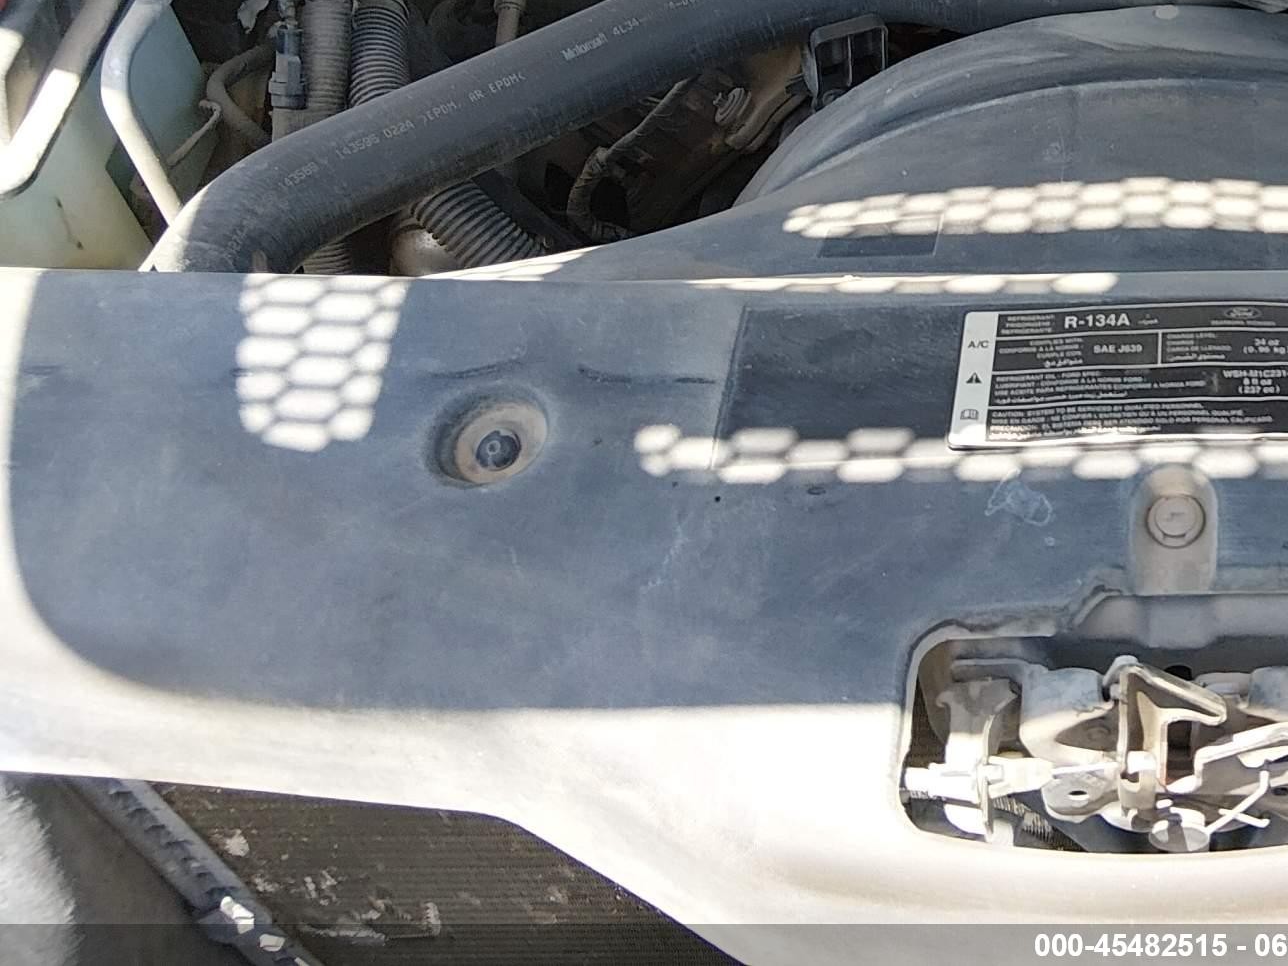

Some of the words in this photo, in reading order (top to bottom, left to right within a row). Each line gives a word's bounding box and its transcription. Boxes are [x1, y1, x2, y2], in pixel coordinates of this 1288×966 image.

[1064, 313, 1130, 330] R-134A
[968, 340, 989, 349] A/C
[1094, 344, 1115, 354] SAE
